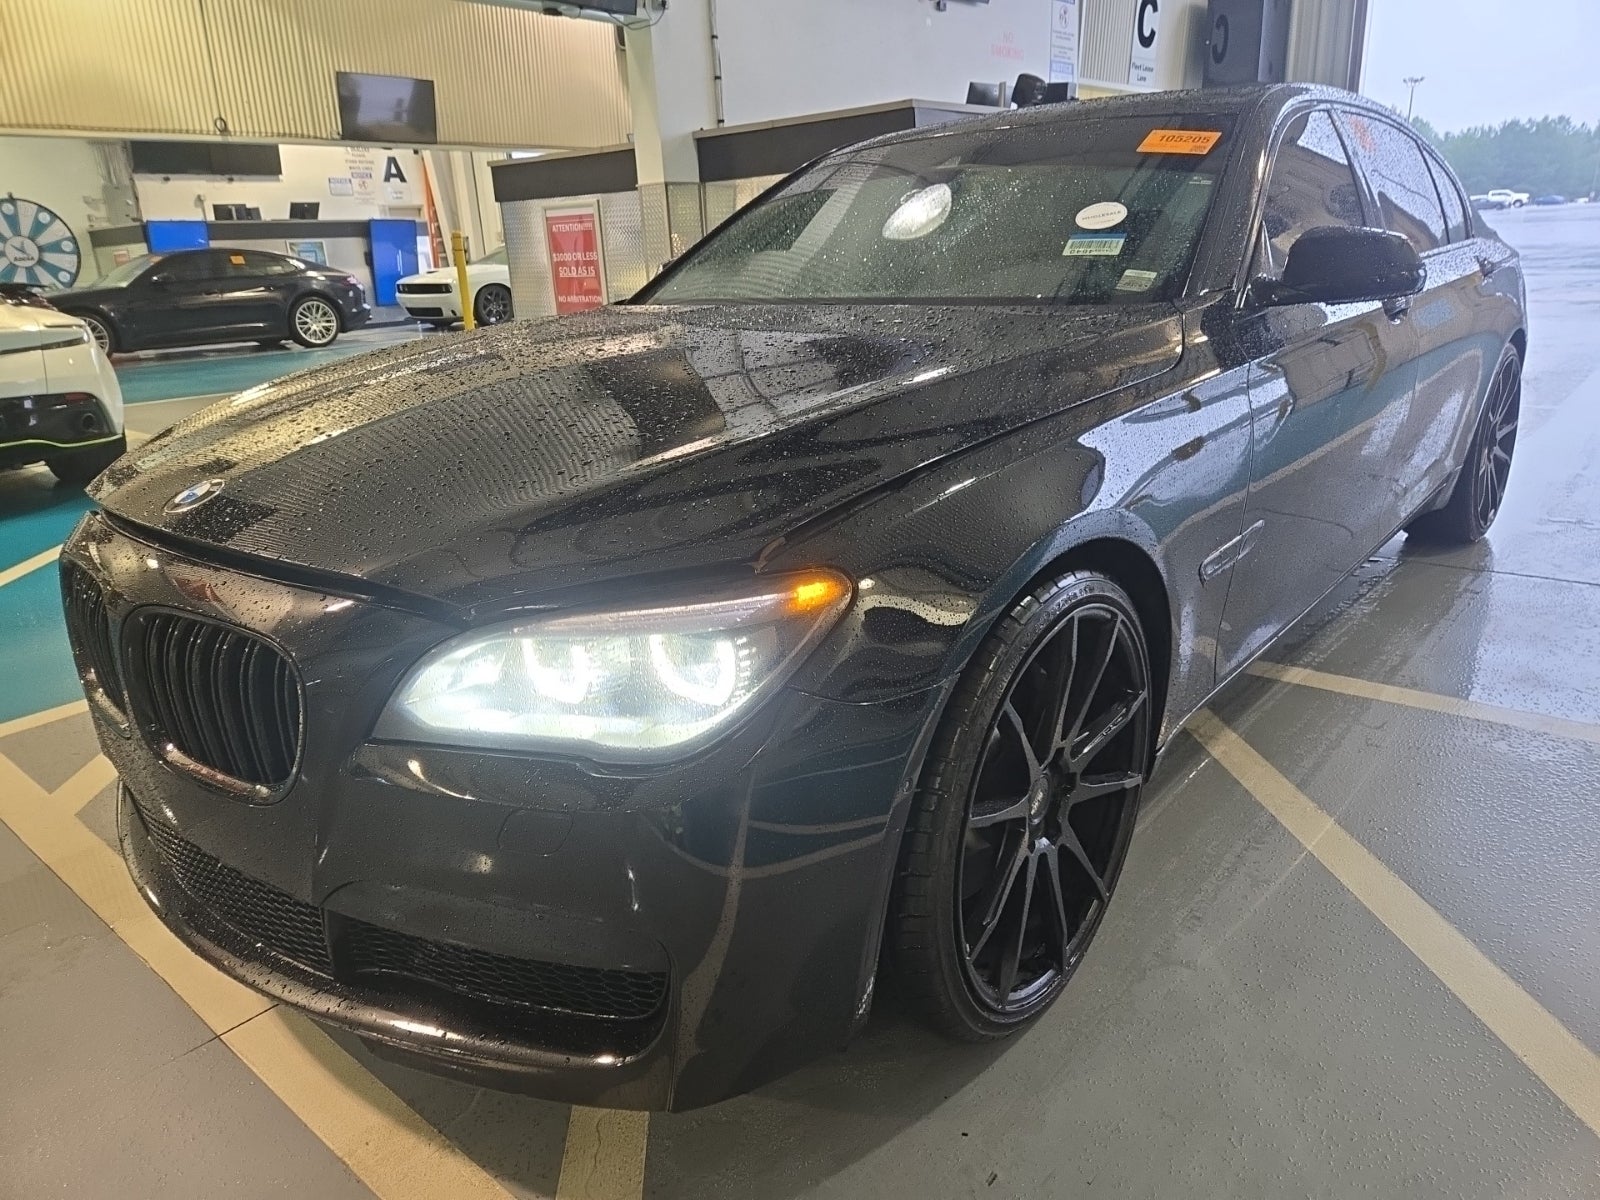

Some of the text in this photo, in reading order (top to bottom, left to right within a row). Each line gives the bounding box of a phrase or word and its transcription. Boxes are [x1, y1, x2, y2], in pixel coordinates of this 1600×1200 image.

[1138, 0, 1158, 48] C
[1160, 134, 1211, 144] 105205
[384, 156, 407, 183] A
[583, 251, 598, 261] LESS
[558, 265, 596, 276] SOLD AS IS
[558, 295, 567, 303] NO
